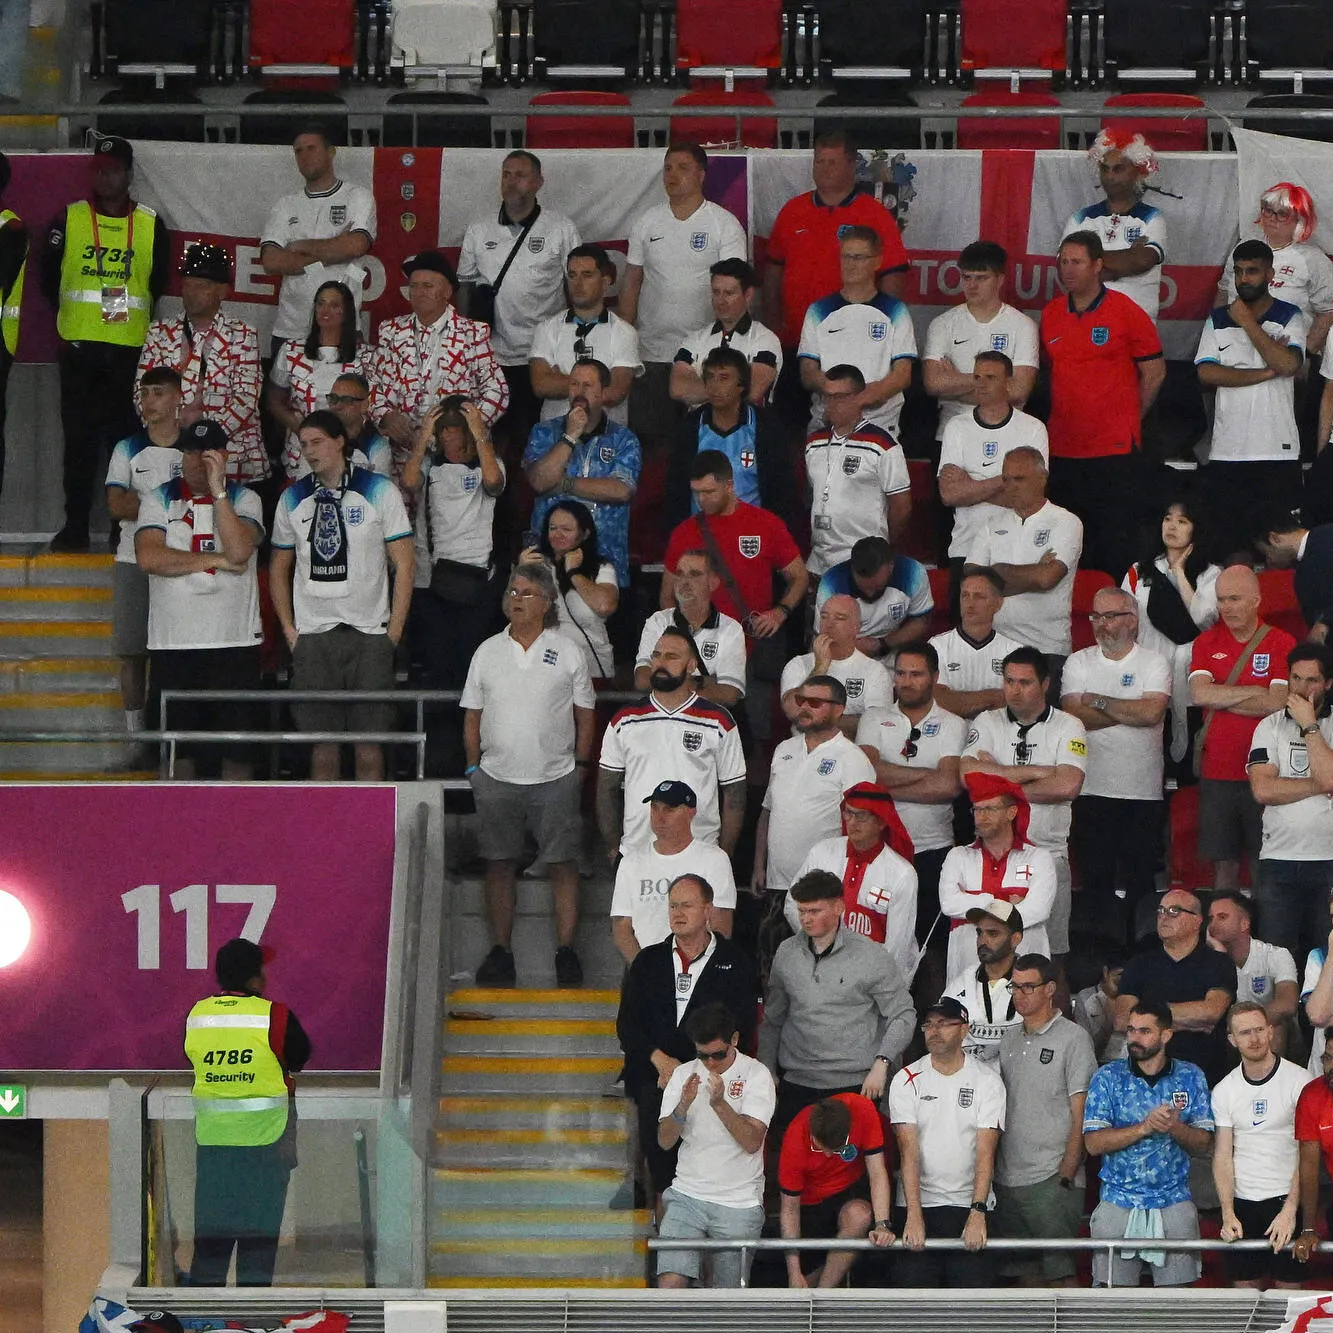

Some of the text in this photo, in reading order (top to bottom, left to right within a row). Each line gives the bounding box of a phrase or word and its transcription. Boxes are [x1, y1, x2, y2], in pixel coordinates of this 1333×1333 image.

[82, 245, 134, 264] 3732
[640, 878, 672, 896] BO
[120, 884, 277, 969] 117
[204, 1049, 253, 1066] 4786
[205, 1071, 255, 1084] Security
